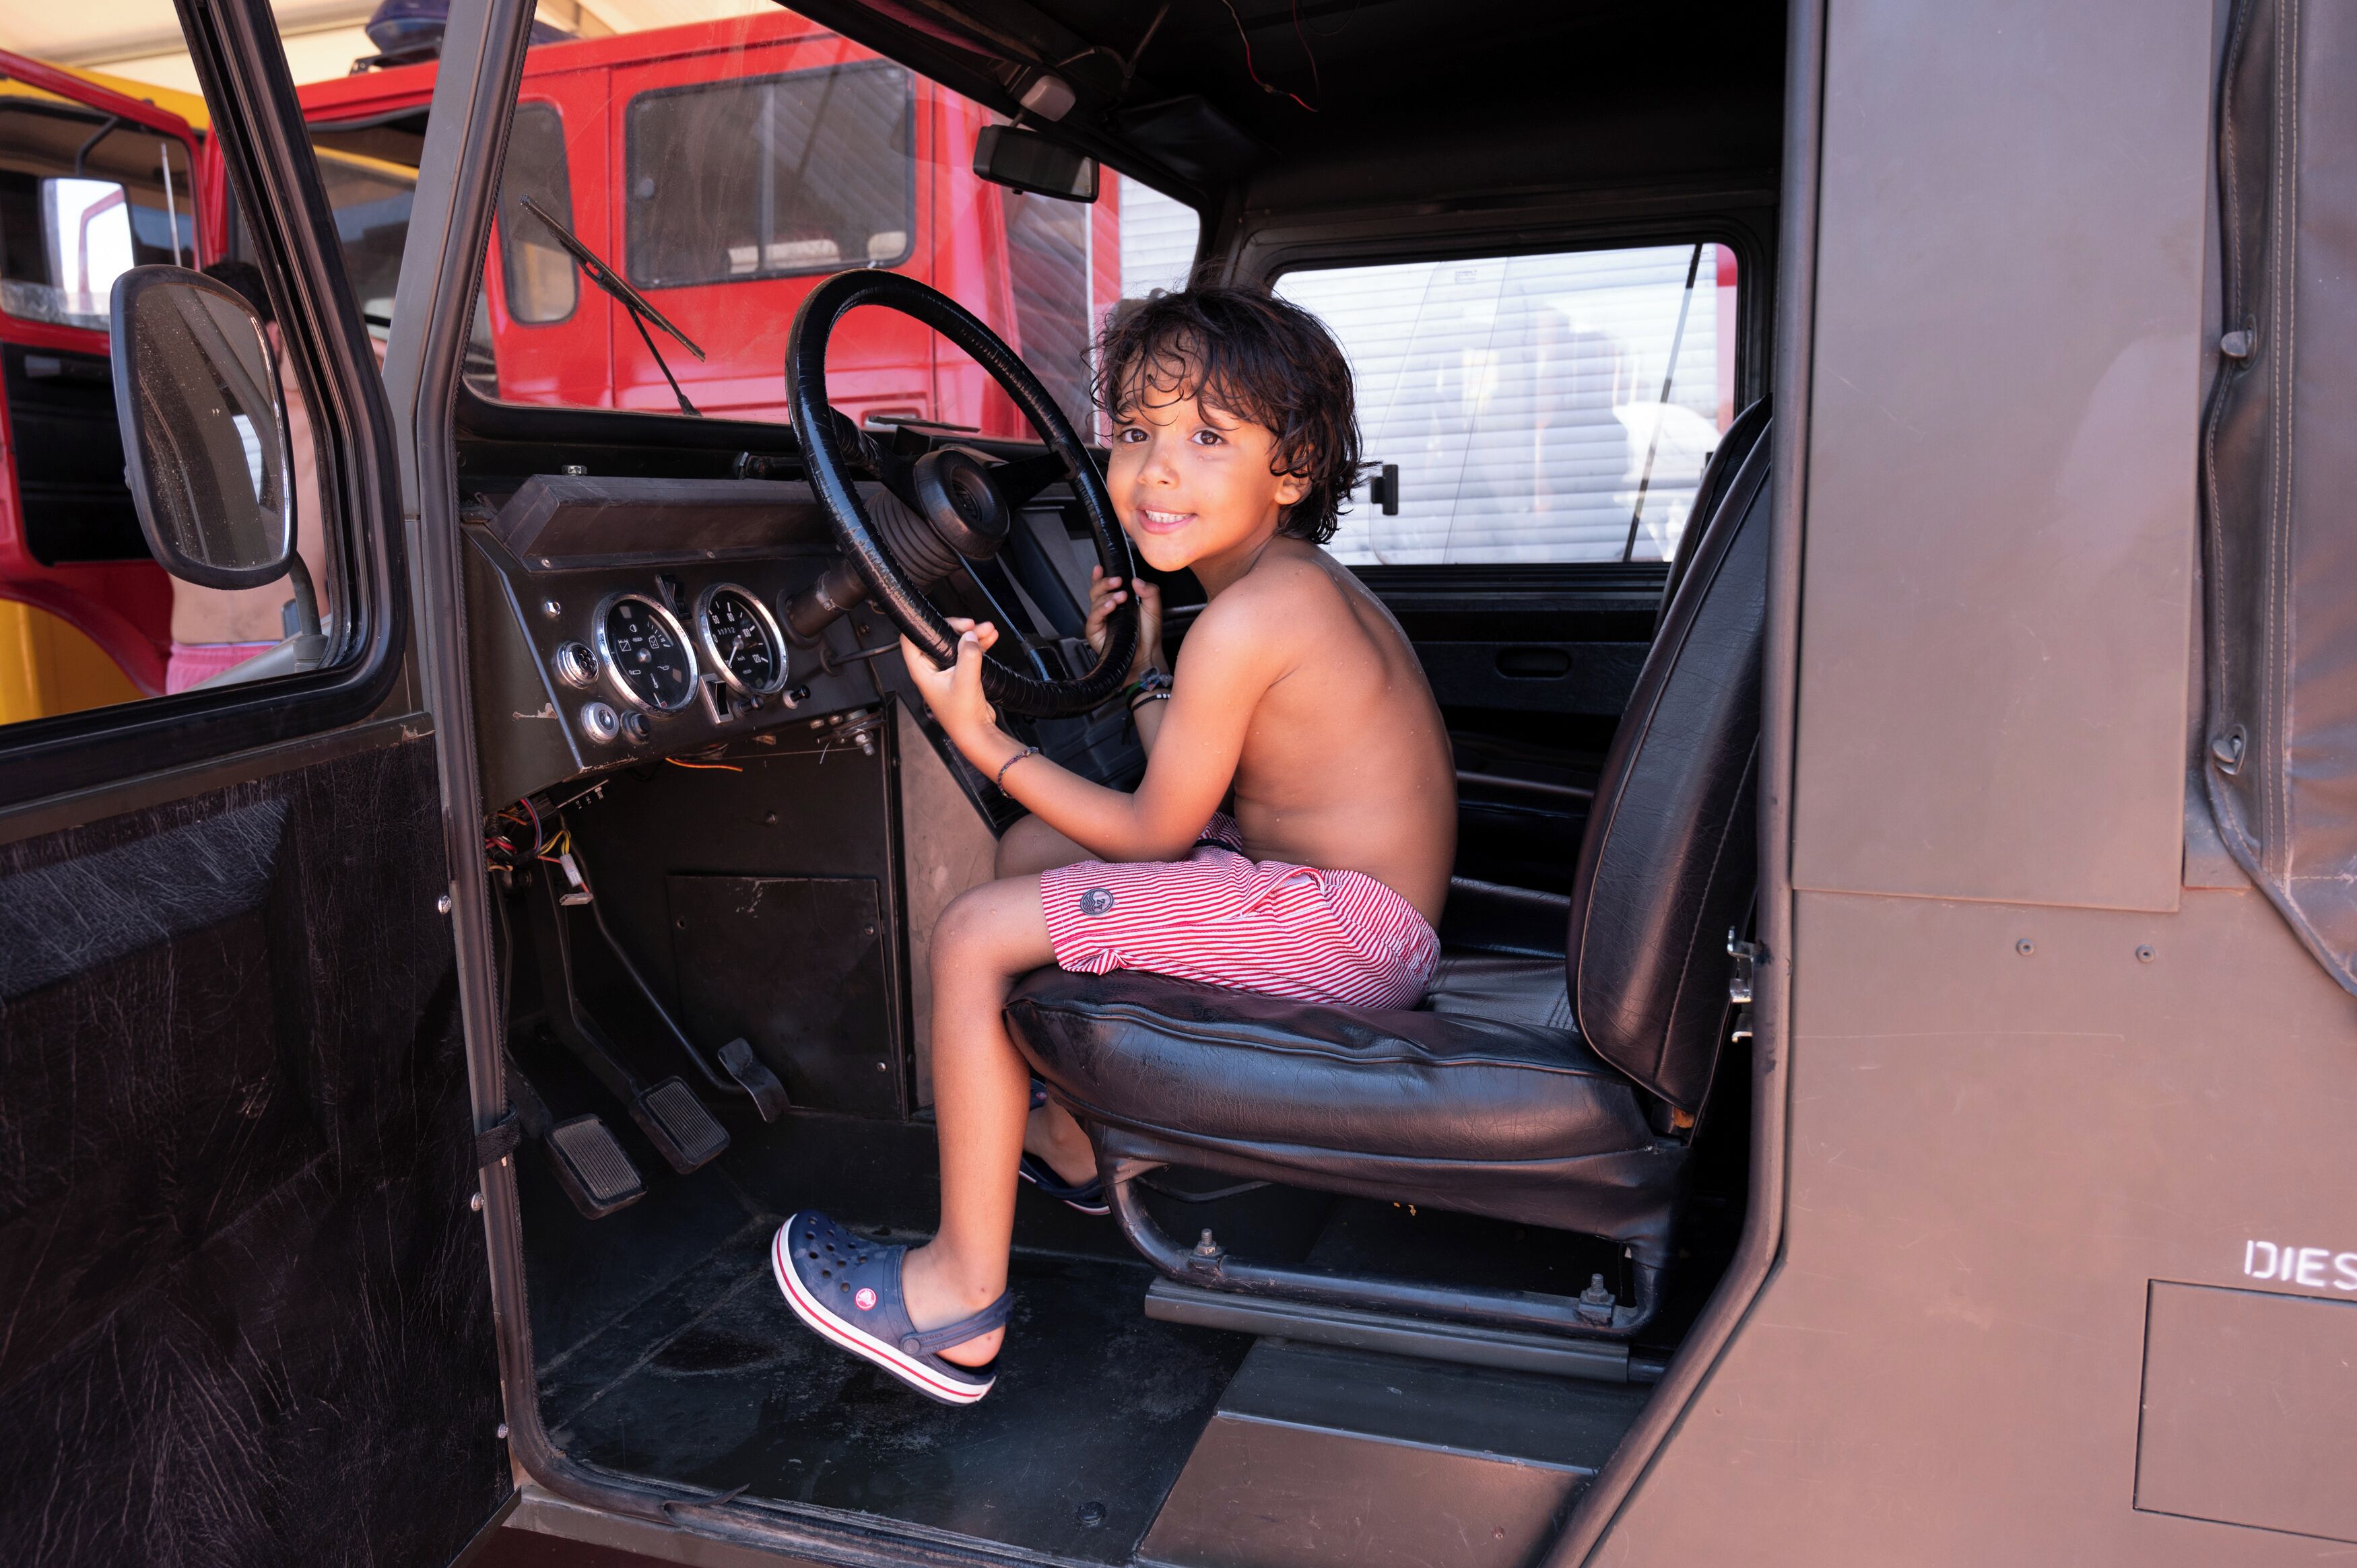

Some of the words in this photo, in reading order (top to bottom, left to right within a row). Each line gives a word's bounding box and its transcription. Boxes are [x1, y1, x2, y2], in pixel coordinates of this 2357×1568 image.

[712, 615, 720, 624] 60
[727, 613, 735, 622] 80
[742, 628, 752, 638] 100
[752, 654, 762, 663] 120
[2244, 1239, 2357, 1291] DIES
